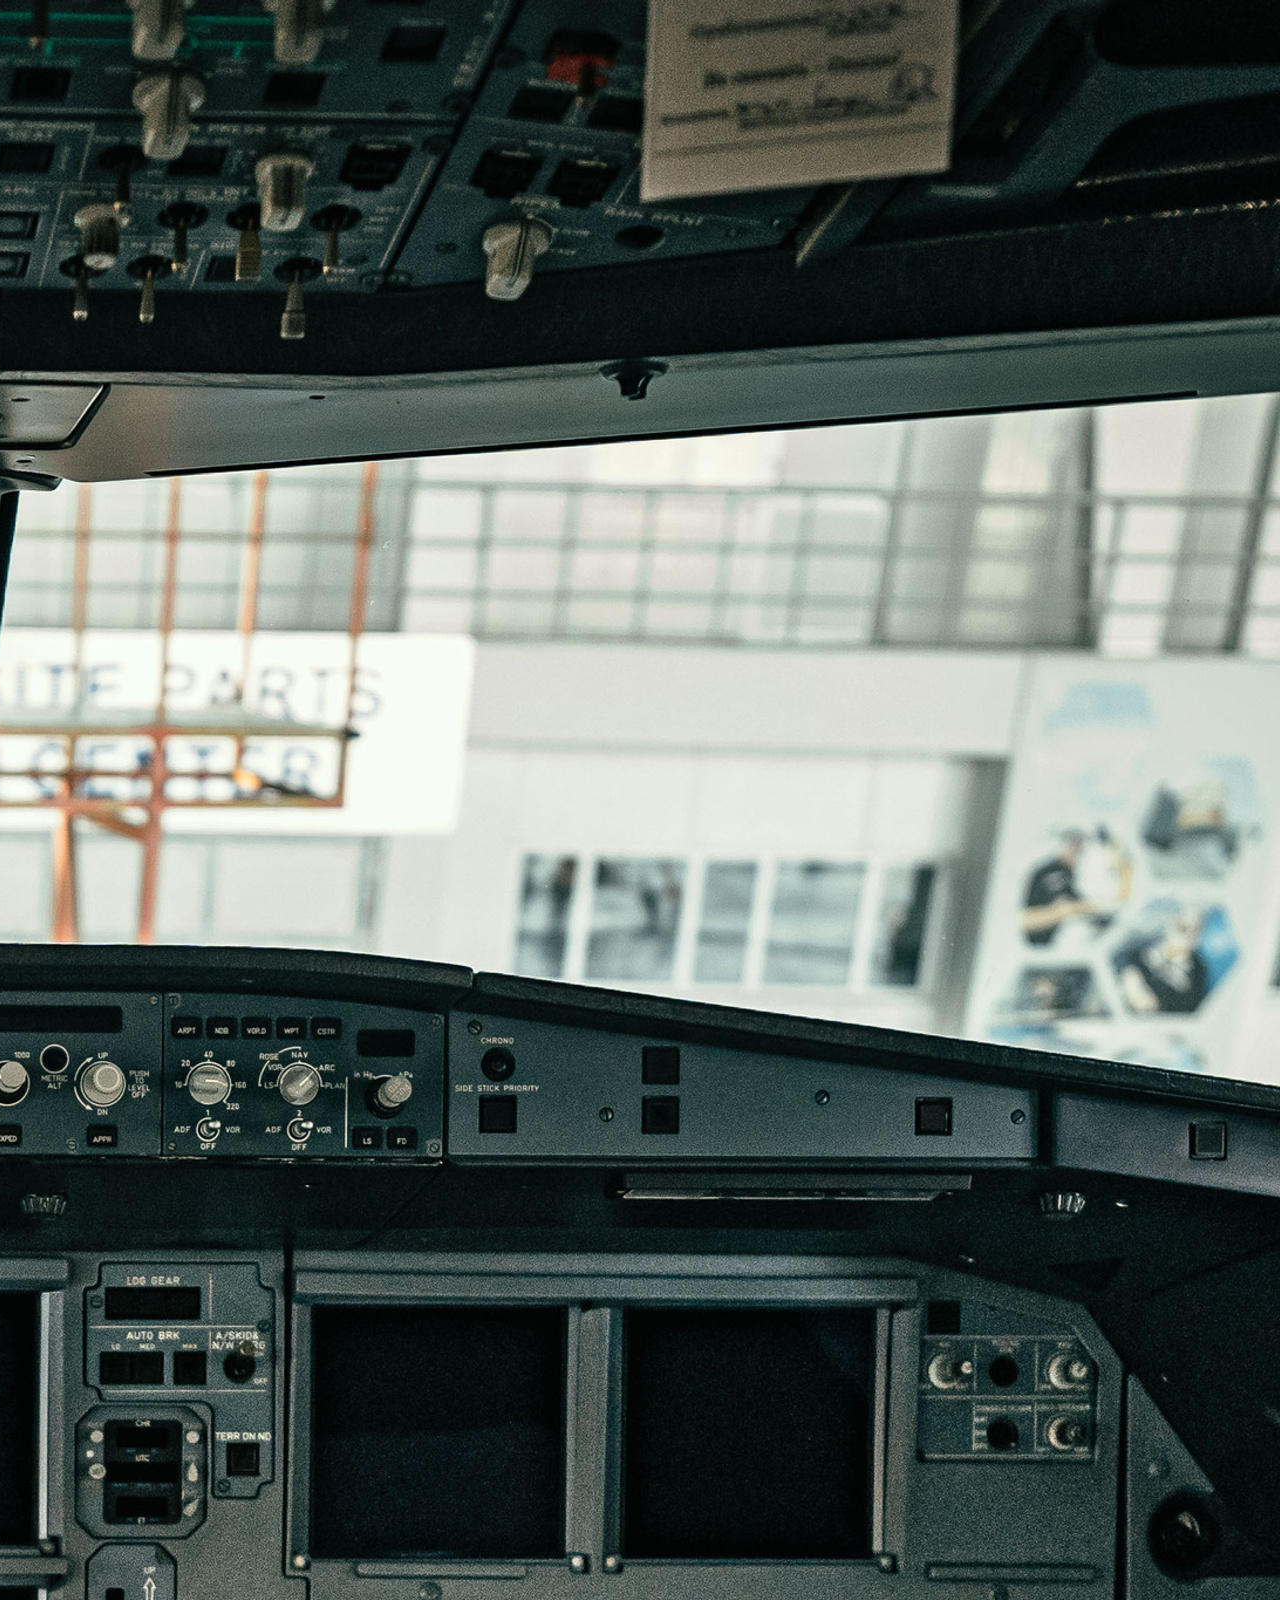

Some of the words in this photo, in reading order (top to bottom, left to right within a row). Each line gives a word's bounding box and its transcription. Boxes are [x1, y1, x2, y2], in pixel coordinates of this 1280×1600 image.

[127, 1277, 146, 1285] LDG
[151, 1276, 180, 1285] GEAR
[126, 1331, 153, 1340] AUTO
[158, 1331, 180, 1340] BRK
[216, 1331, 258, 1340] A/SKID&
[215, 1432, 239, 1440] TERR
[243, 1432, 256, 1441] ON
[258, 1432, 271, 1441] ND
